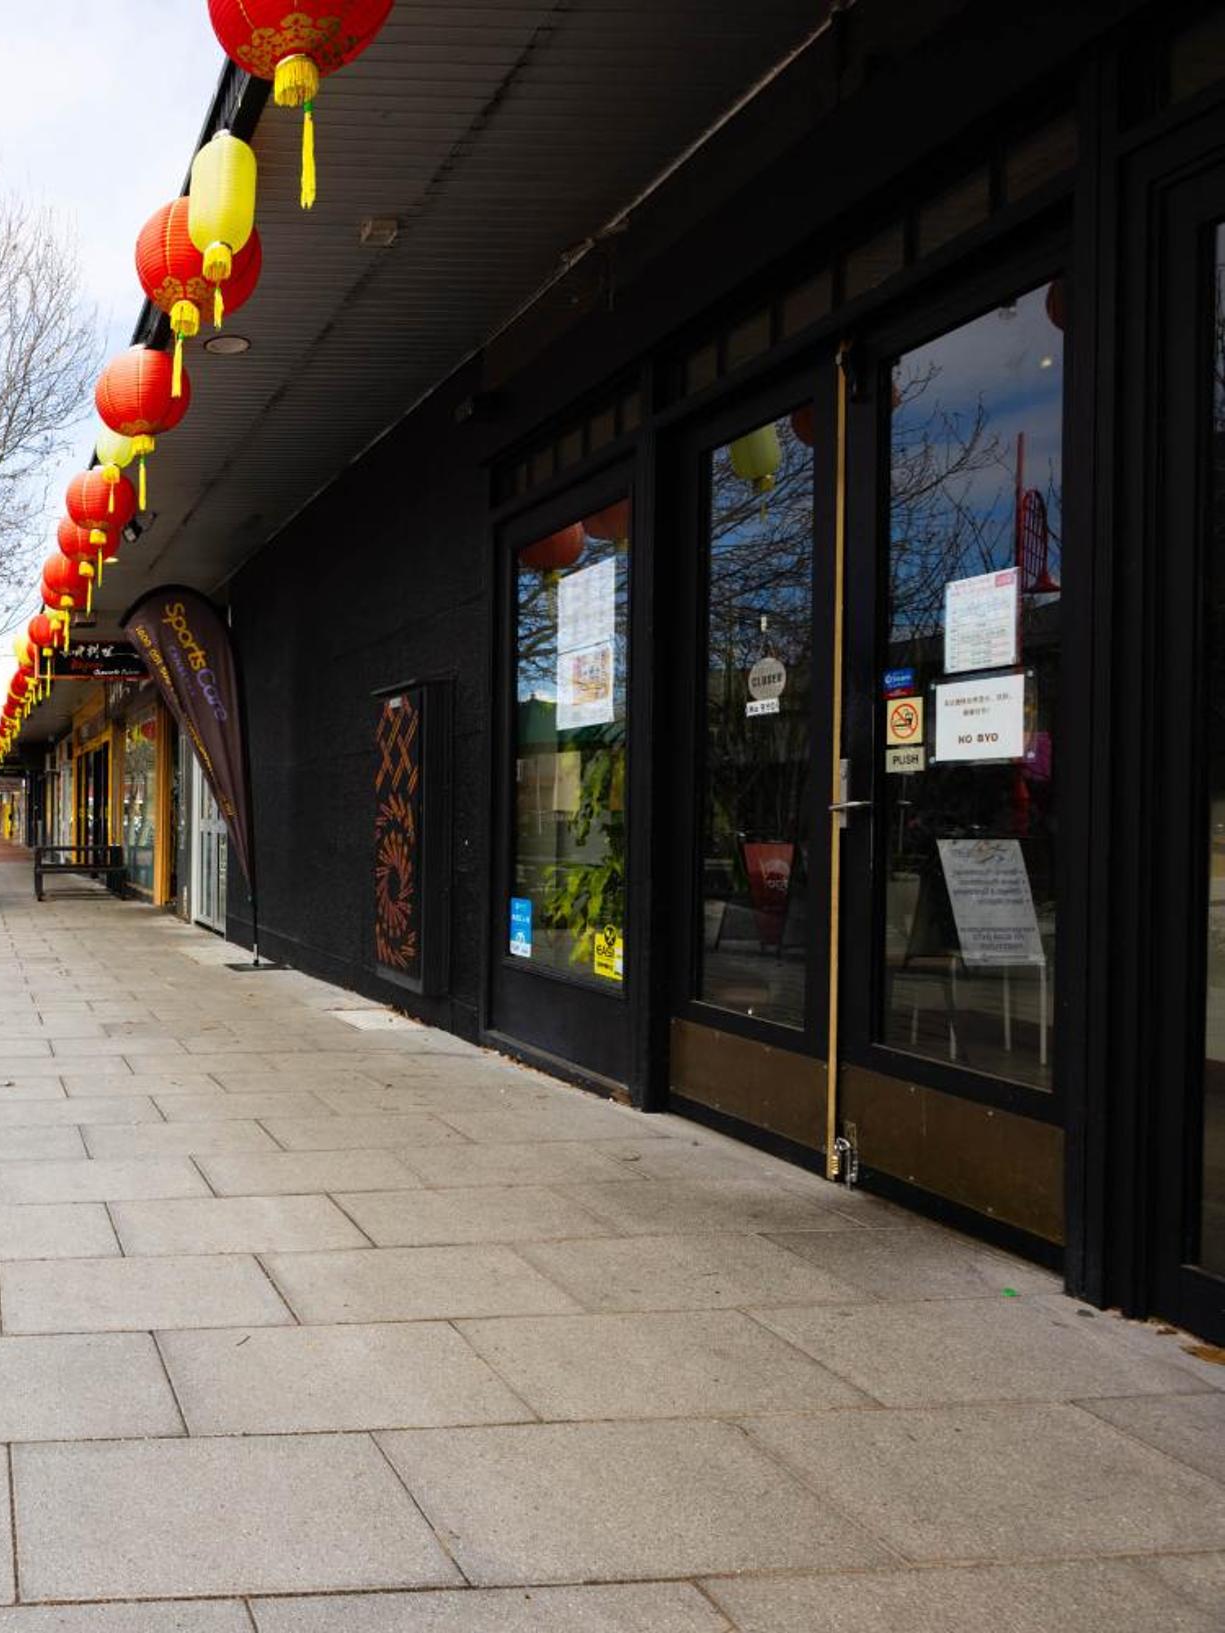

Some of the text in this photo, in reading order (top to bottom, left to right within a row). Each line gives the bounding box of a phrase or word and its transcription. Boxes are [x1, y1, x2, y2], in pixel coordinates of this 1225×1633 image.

[958, 732, 999, 744] NO BYO
[892, 754, 919, 765] PUSH
